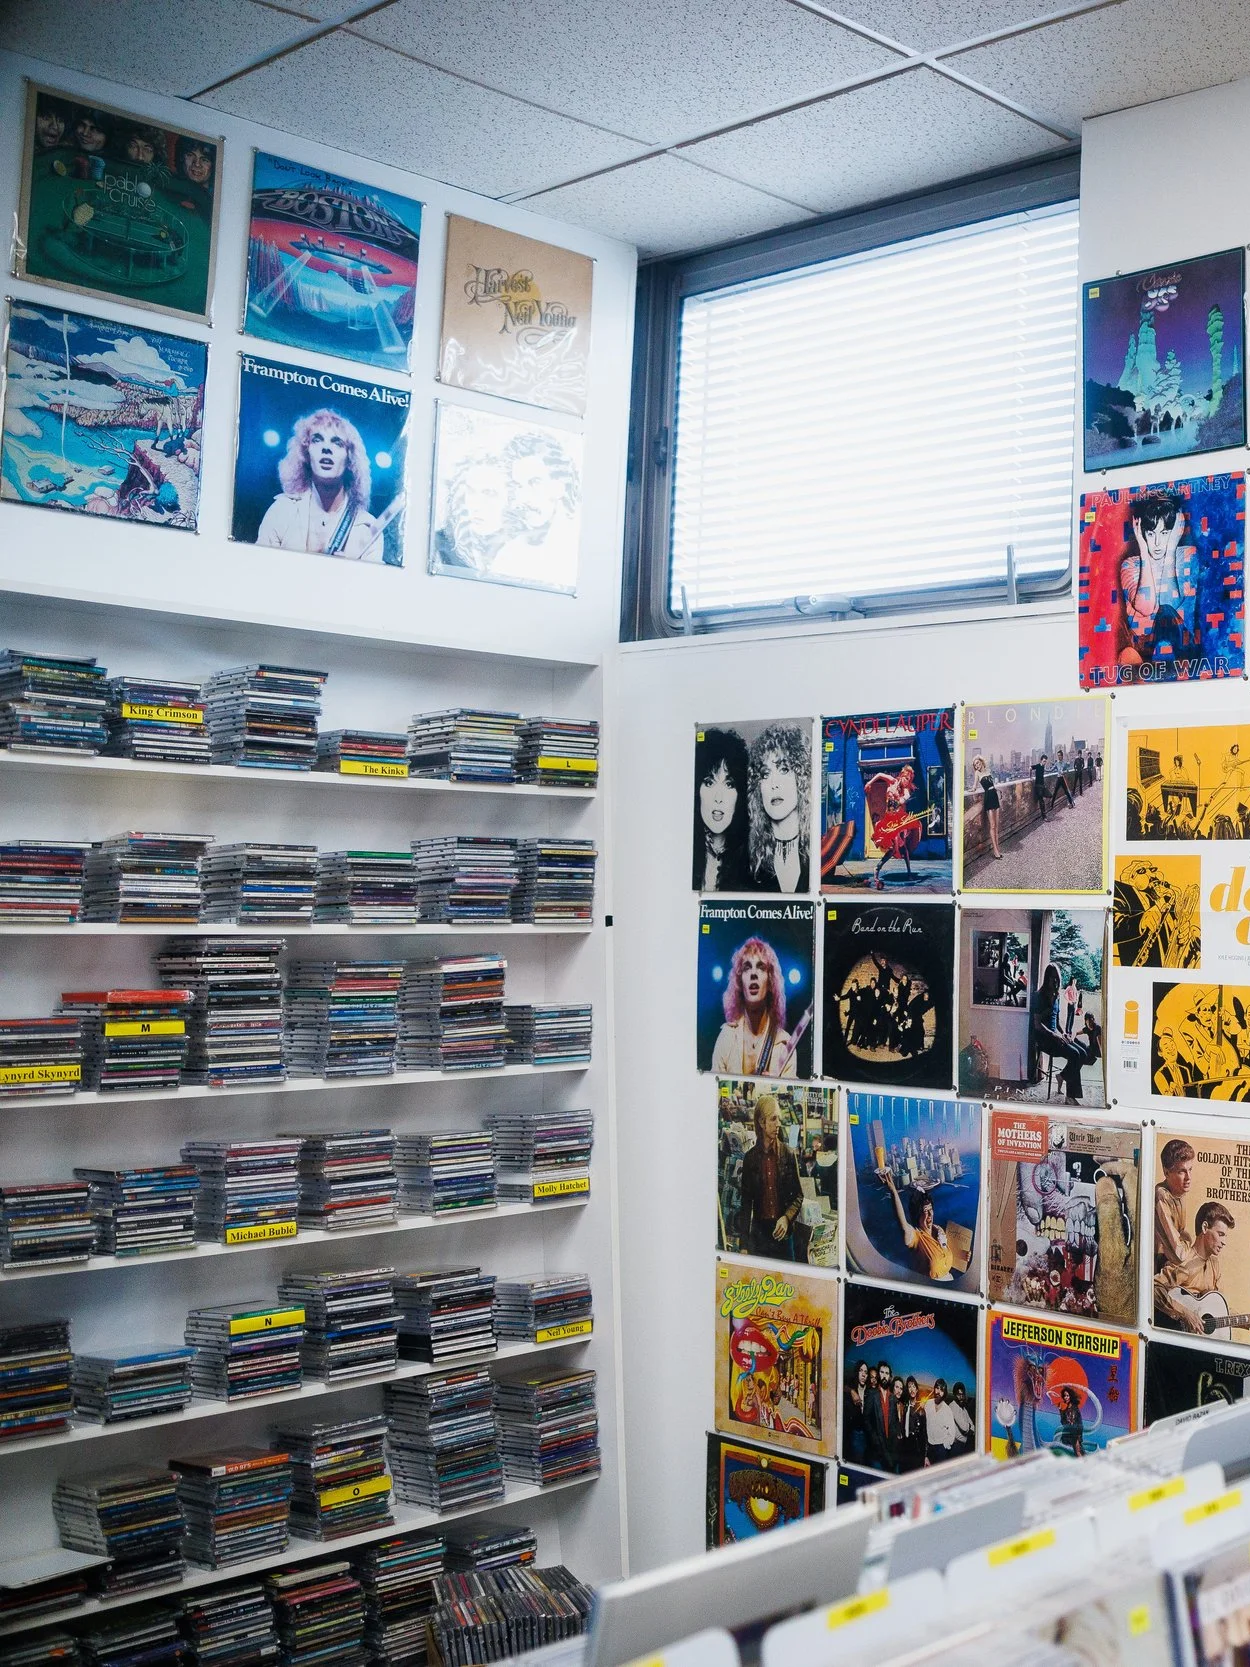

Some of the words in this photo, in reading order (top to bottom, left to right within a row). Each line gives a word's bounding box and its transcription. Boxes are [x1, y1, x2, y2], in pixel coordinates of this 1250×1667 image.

[258, 190, 408, 244] BOSTON
[464, 264, 534, 307] Harvest
[498, 300, 534, 334] Neil
[532, 298, 577, 328] Young
[243, 357, 318, 387] Frampton
[319, 374, 368, 399] Comes
[369, 387, 410, 408] Alive!
[1091, 489, 1133, 507] PAUL
[1090, 665, 1133, 684] TUG
[1138, 661, 1166, 681] OF
[1174, 657, 1230, 678] WAR
[129, 705, 153, 718] King
[156, 707, 198, 720] Crimson
[968, 702, 1103, 724] BLONDIE
[825, 718, 879, 738] CYNDI
[885, 712, 953, 733] LAUPER
[363, 765, 379, 774] The
[381, 766, 405, 776] Kinks
[700, 904, 747, 921] Frampton
[747, 905, 782, 920] Comes
[782, 905, 814, 920] Alive!
[851, 916, 879, 934] Band
[886, 916, 901, 933] the
[902, 917, 923, 935] Run
[141, 1024, 151, 1033] M
[0, 1070, 35, 1083] ynyrd
[38, 1067, 80, 1081] Skynyrd
[1013, 1122, 1026, 1130] THE
[997, 1127, 1042, 1142] MOTHERS
[997, 1139, 1006, 1147] OF
[1006, 1140, 1042, 1150] INVENTION
[1197, 1151, 1232, 1164] GOLDEN
[1221, 1166, 1233, 1177] OF
[537, 1185, 558, 1195] Molly
[559, 1181, 587, 1191] Hatchet
[230, 1230, 266, 1242] Michael
[269, 1225, 294, 1236] Bublé
[721, 1279, 760, 1319] Steely
[760, 1275, 795, 1304] Dan
[883, 1304, 900, 1319] The
[264, 1318, 272, 1326] N
[851, 1320, 892, 1346] Doobie
[889, 1312, 936, 1338] Brothers
[546, 1328, 561, 1338] Neil
[561, 1324, 585, 1335] Young
[1003, 1320, 1063, 1346] JEFFERSON
[1065, 1331, 1119, 1355] STARSHIP
[352, 1487, 360, 1496] O
